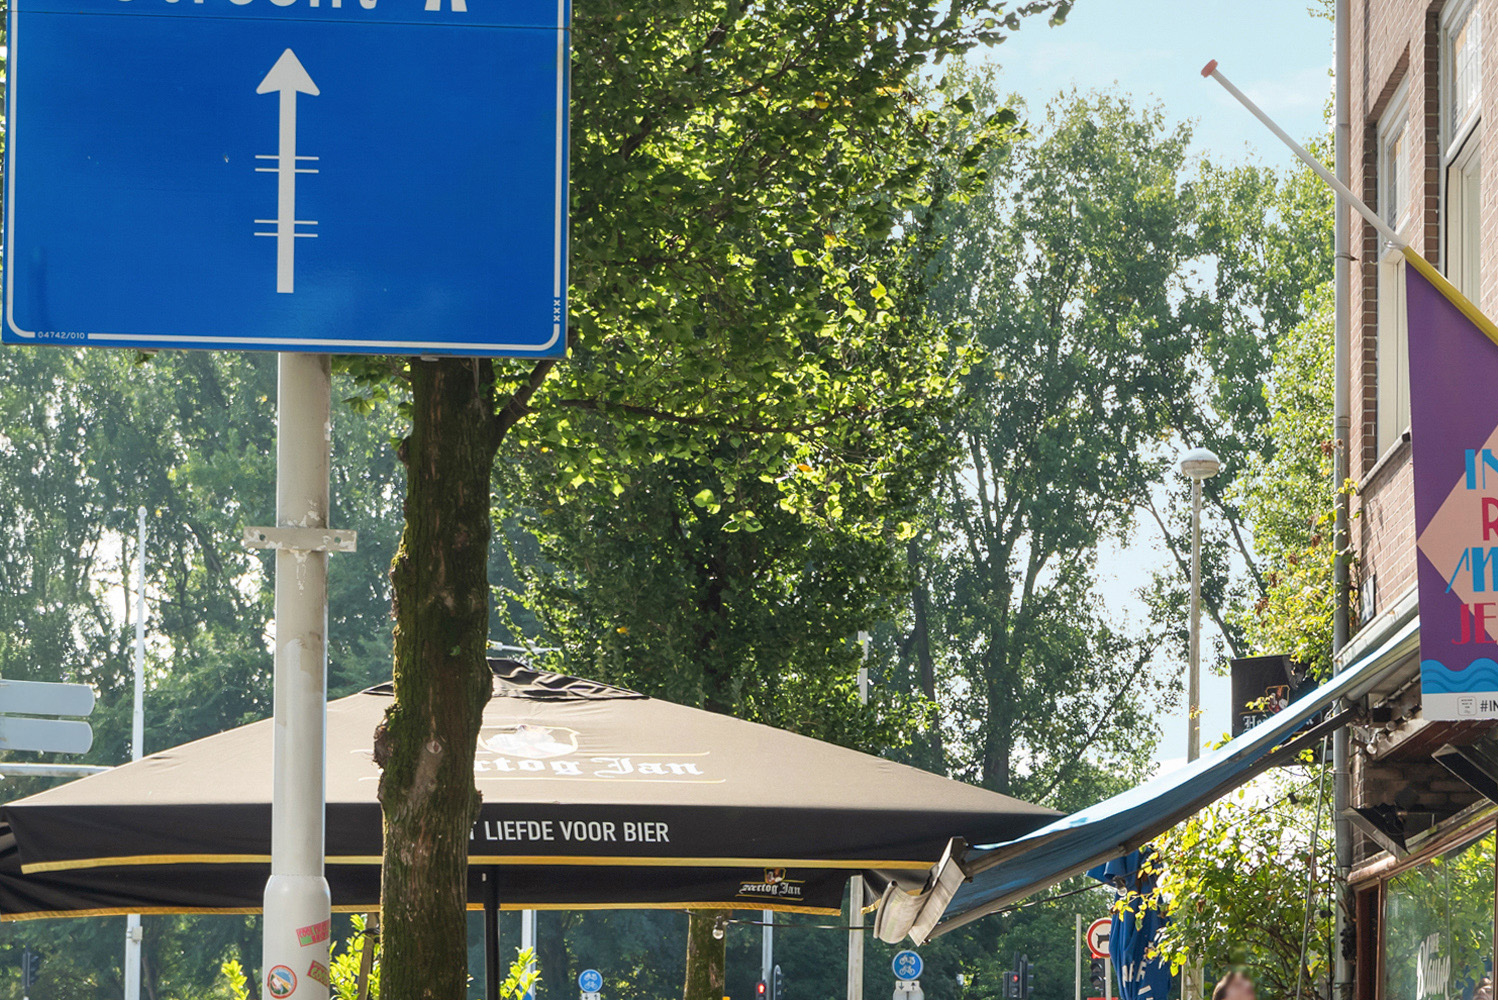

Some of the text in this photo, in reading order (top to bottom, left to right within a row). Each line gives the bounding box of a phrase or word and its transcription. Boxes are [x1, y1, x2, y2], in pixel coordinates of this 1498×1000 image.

[37, 331, 86, 340] 04742/010
[1451, 602, 1498, 645] JE
[484, 821, 555, 841] LIEFDE
[559, 821, 617, 841] VOOR
[623, 822, 670, 843] BIER
